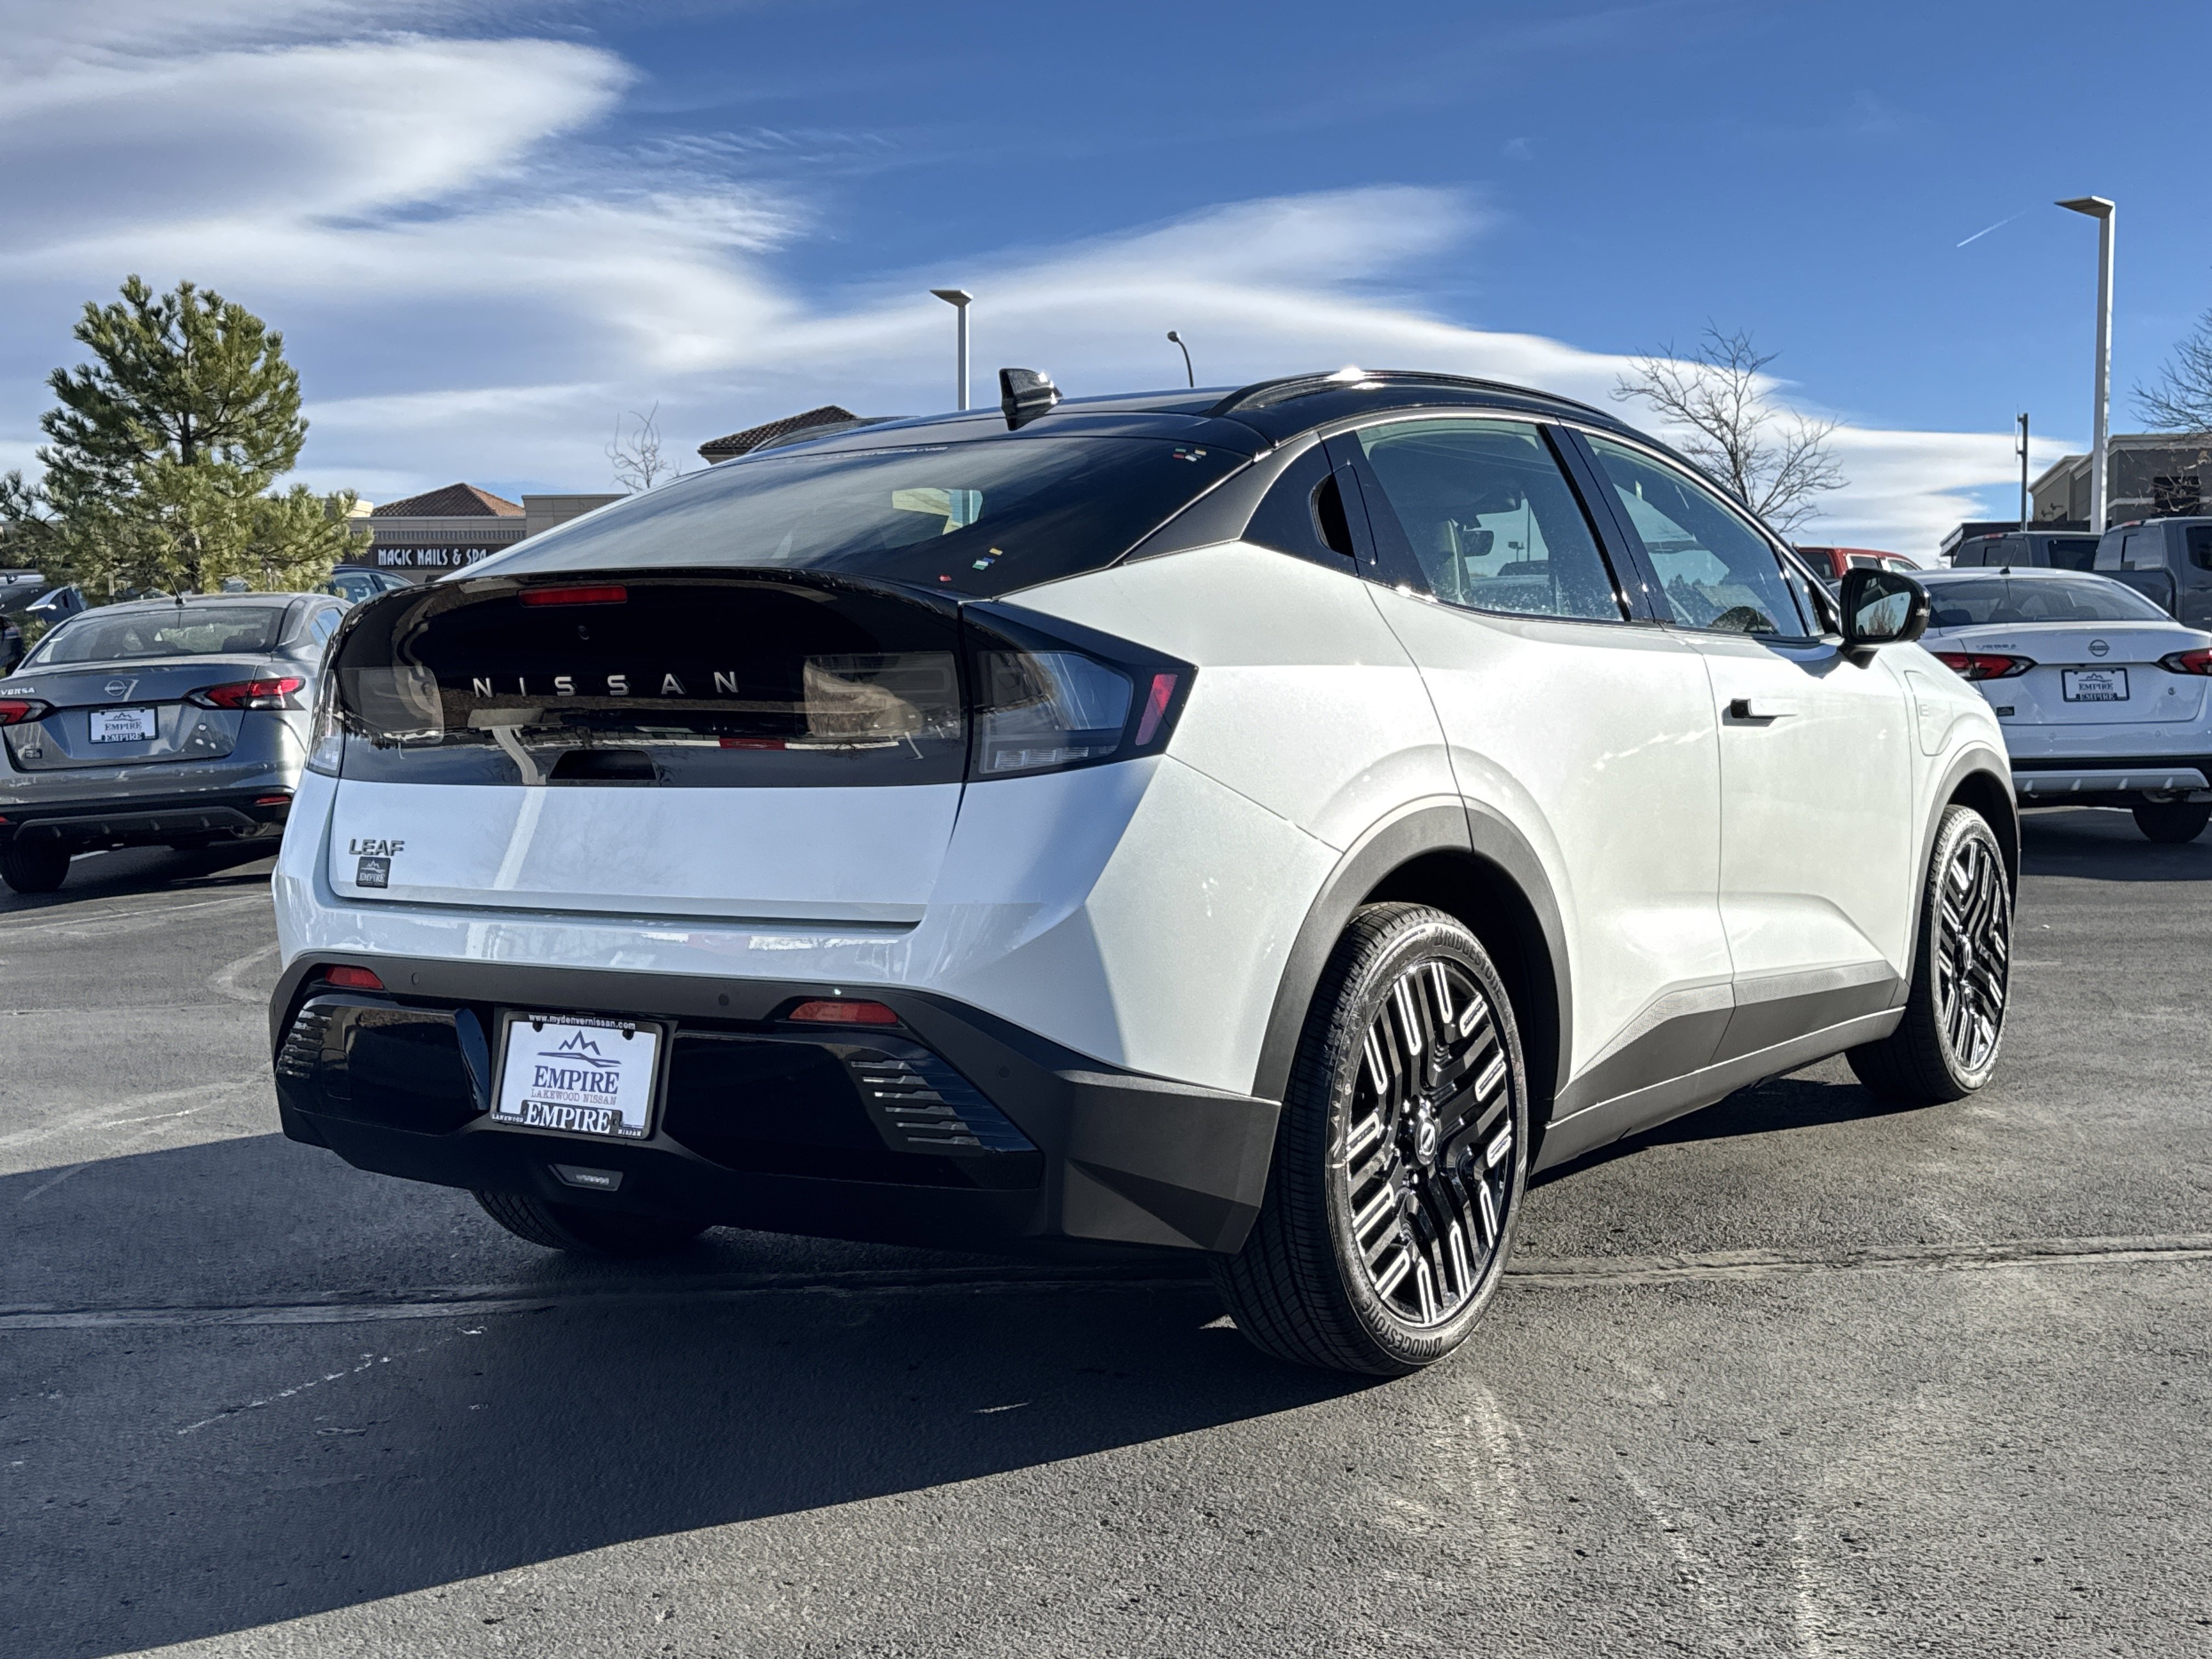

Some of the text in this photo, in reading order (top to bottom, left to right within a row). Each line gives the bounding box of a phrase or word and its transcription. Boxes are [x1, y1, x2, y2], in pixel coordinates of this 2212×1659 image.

[378, 549, 413, 566] MAGIC
[417, 549, 448, 566] NAILS
[453, 549, 462, 565] &
[1, 687, 35, 696] VERSA
[473, 672, 738, 698] NISSAN
[105, 722, 142, 731] EMPIRE
[349, 839, 405, 856] LEAF
[532, 1065, 619, 1094] EMPIRE
[531, 1088, 617, 1105] LAKEWOOD NISSAN
[524, 1101, 612, 1134] EMPIRE
[1361, 1296, 1443, 1358] BRIDGESTONE
